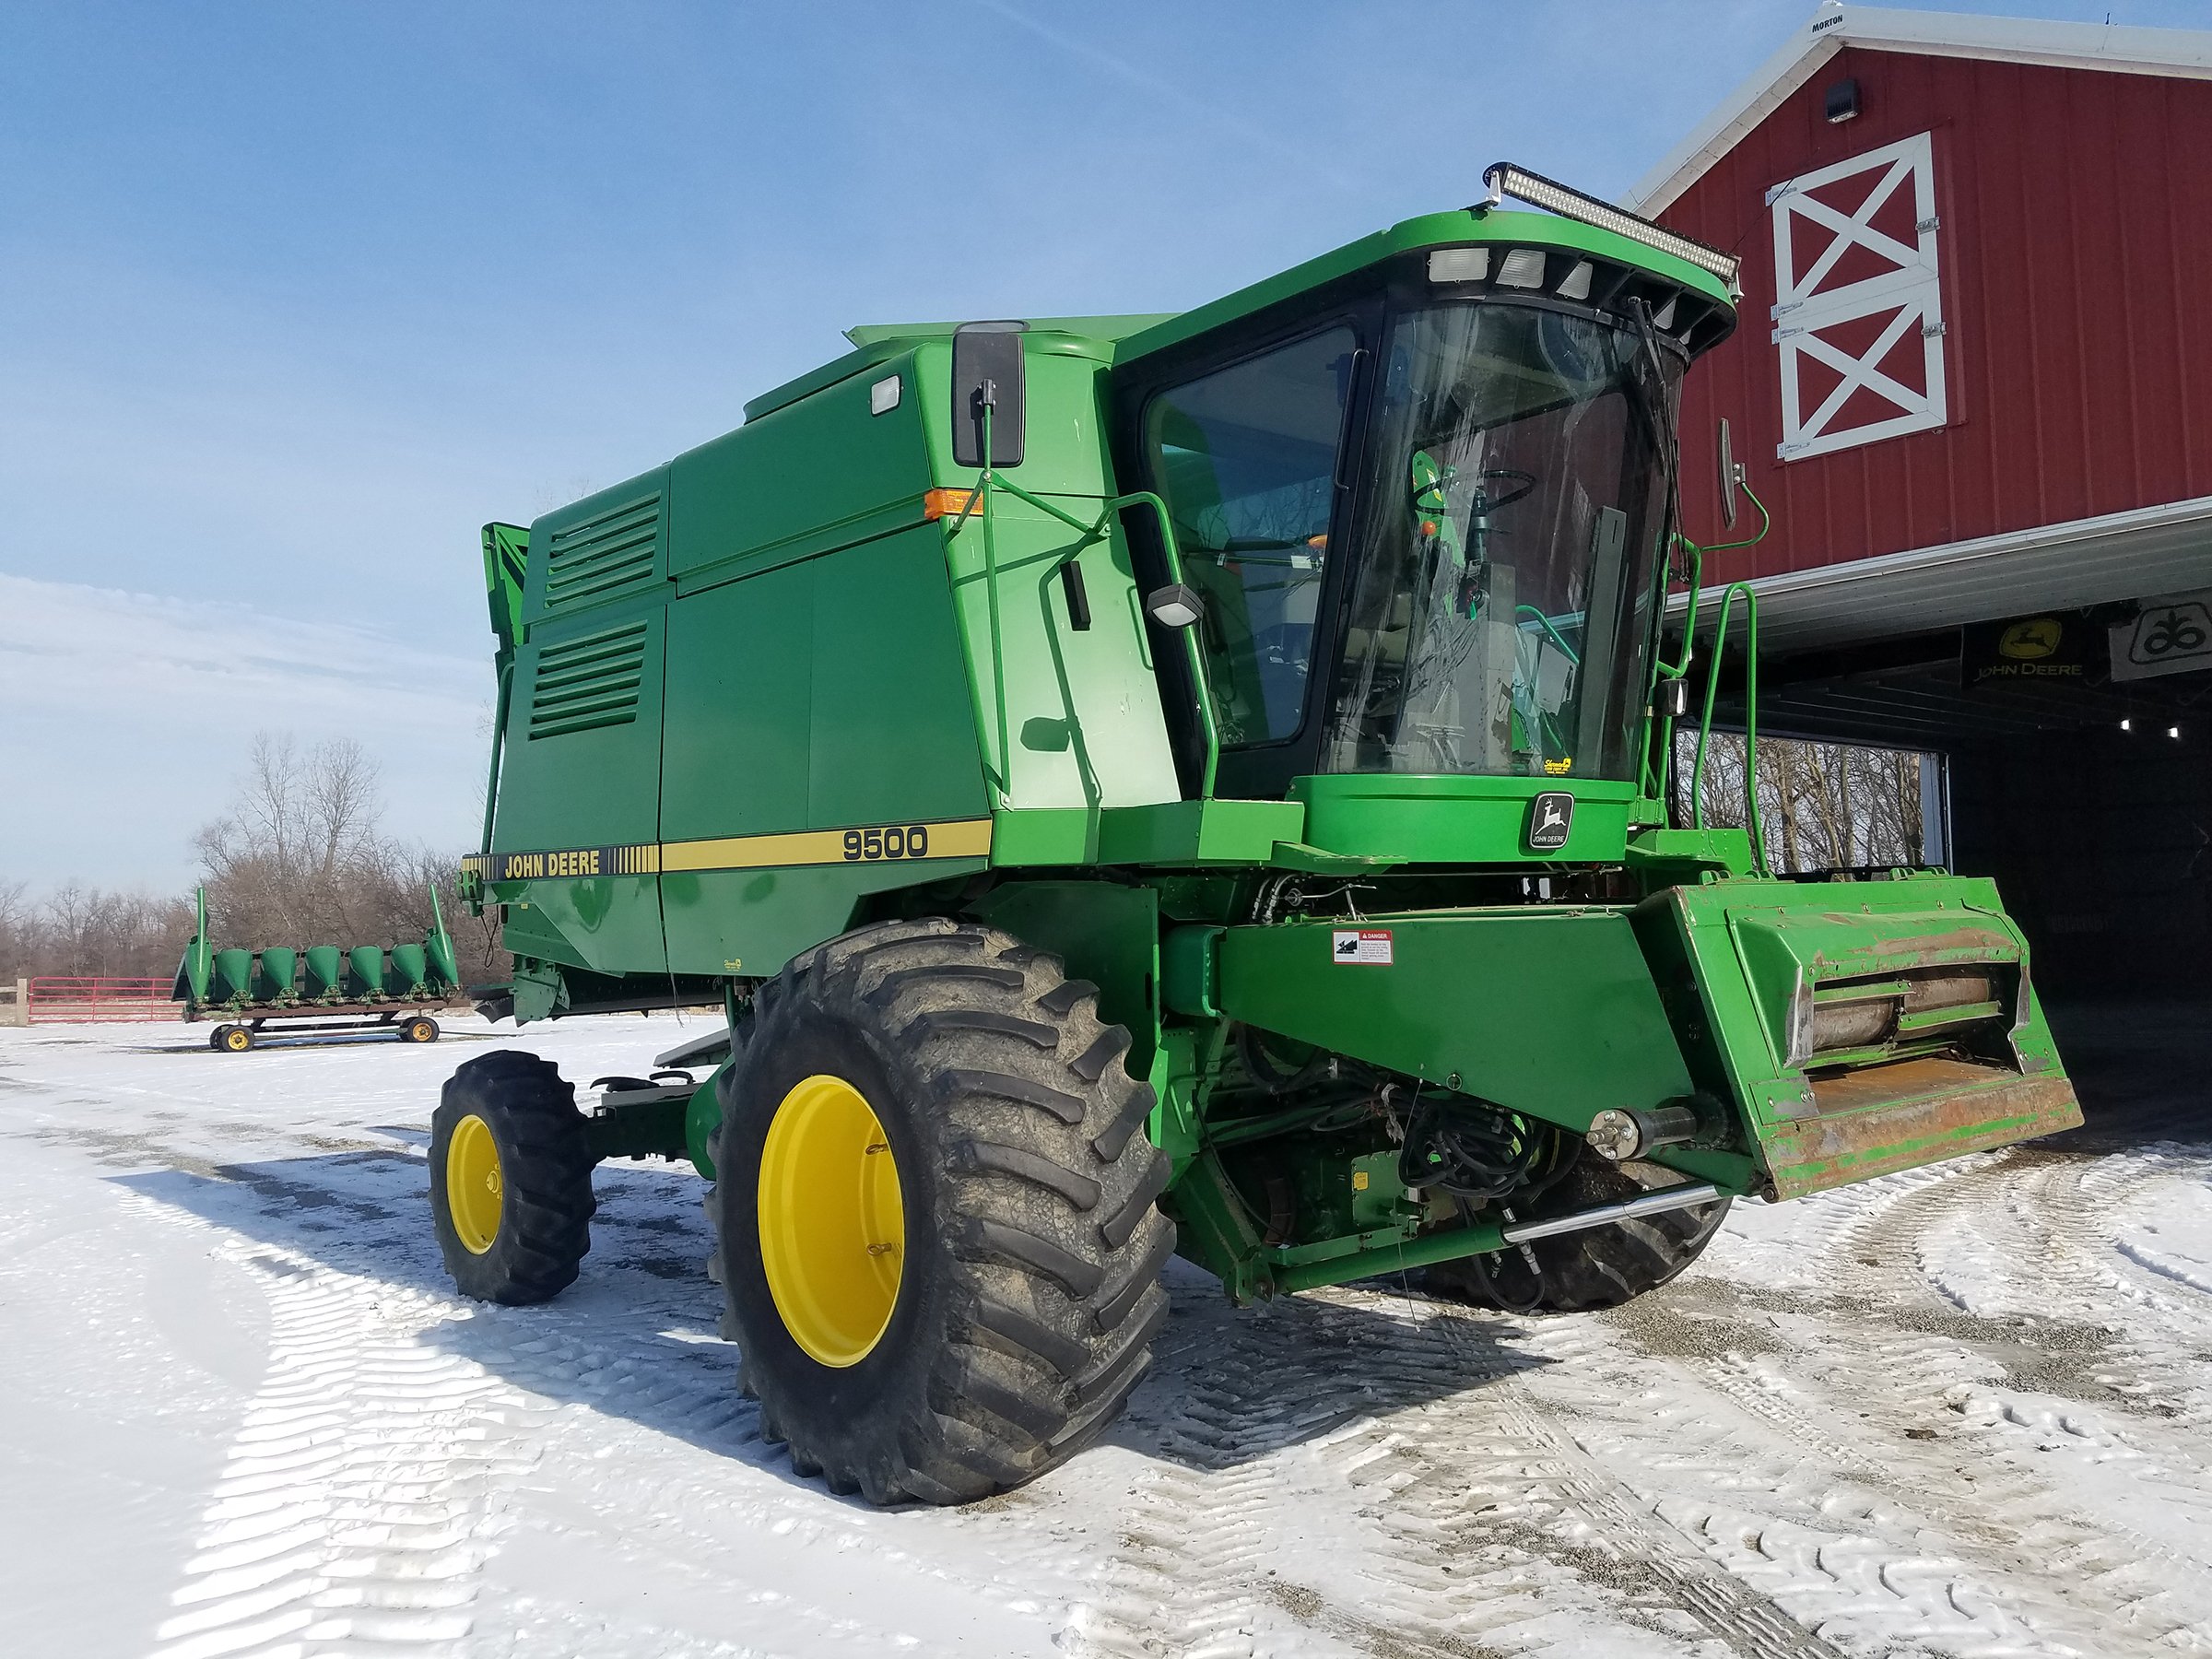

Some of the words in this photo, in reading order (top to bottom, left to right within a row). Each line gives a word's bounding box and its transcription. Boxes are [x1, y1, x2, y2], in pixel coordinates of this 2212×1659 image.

[1812, 14, 1843, 33] MORTON
[1973, 665, 2018, 682] JOHN
[2021, 663, 2083, 676] DEERE
[843, 826, 928, 860] 9500
[505, 854, 543, 878] JOHN
[547, 850, 599, 876] DEERE
